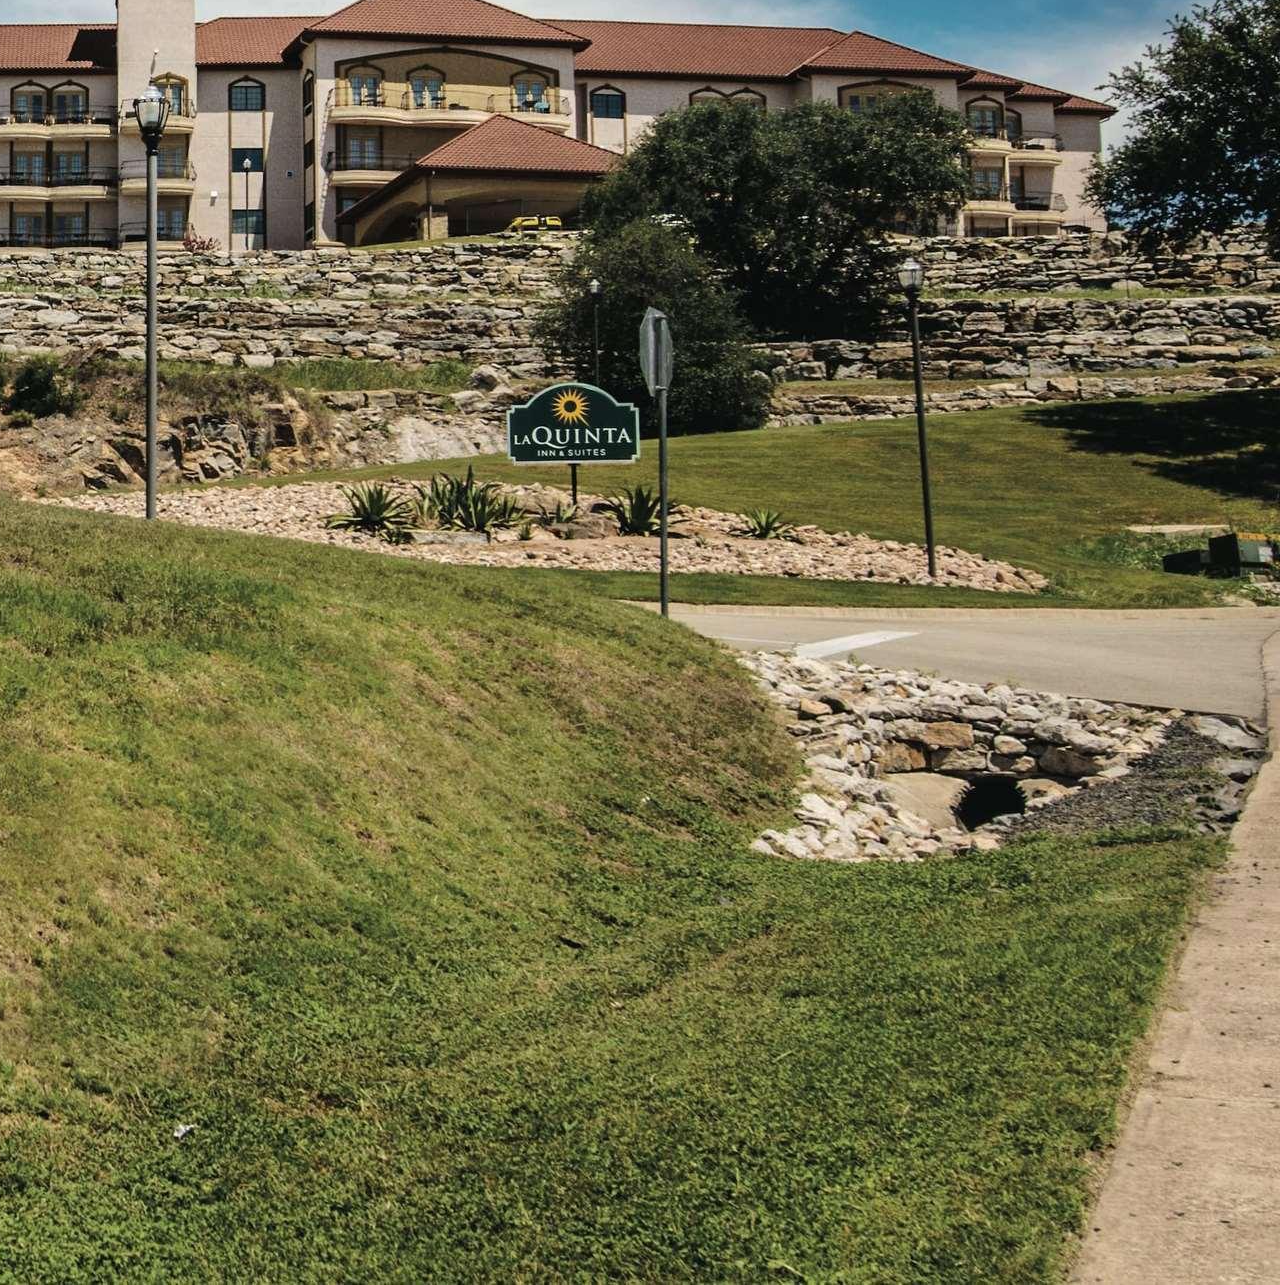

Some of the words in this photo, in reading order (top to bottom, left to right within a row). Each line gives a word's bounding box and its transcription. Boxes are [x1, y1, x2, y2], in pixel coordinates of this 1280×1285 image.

[514, 435, 531, 445] LA
[532, 426, 633, 449] QUINTA
[537, 449, 556, 457] INN
[567, 448, 607, 456] SUITES
